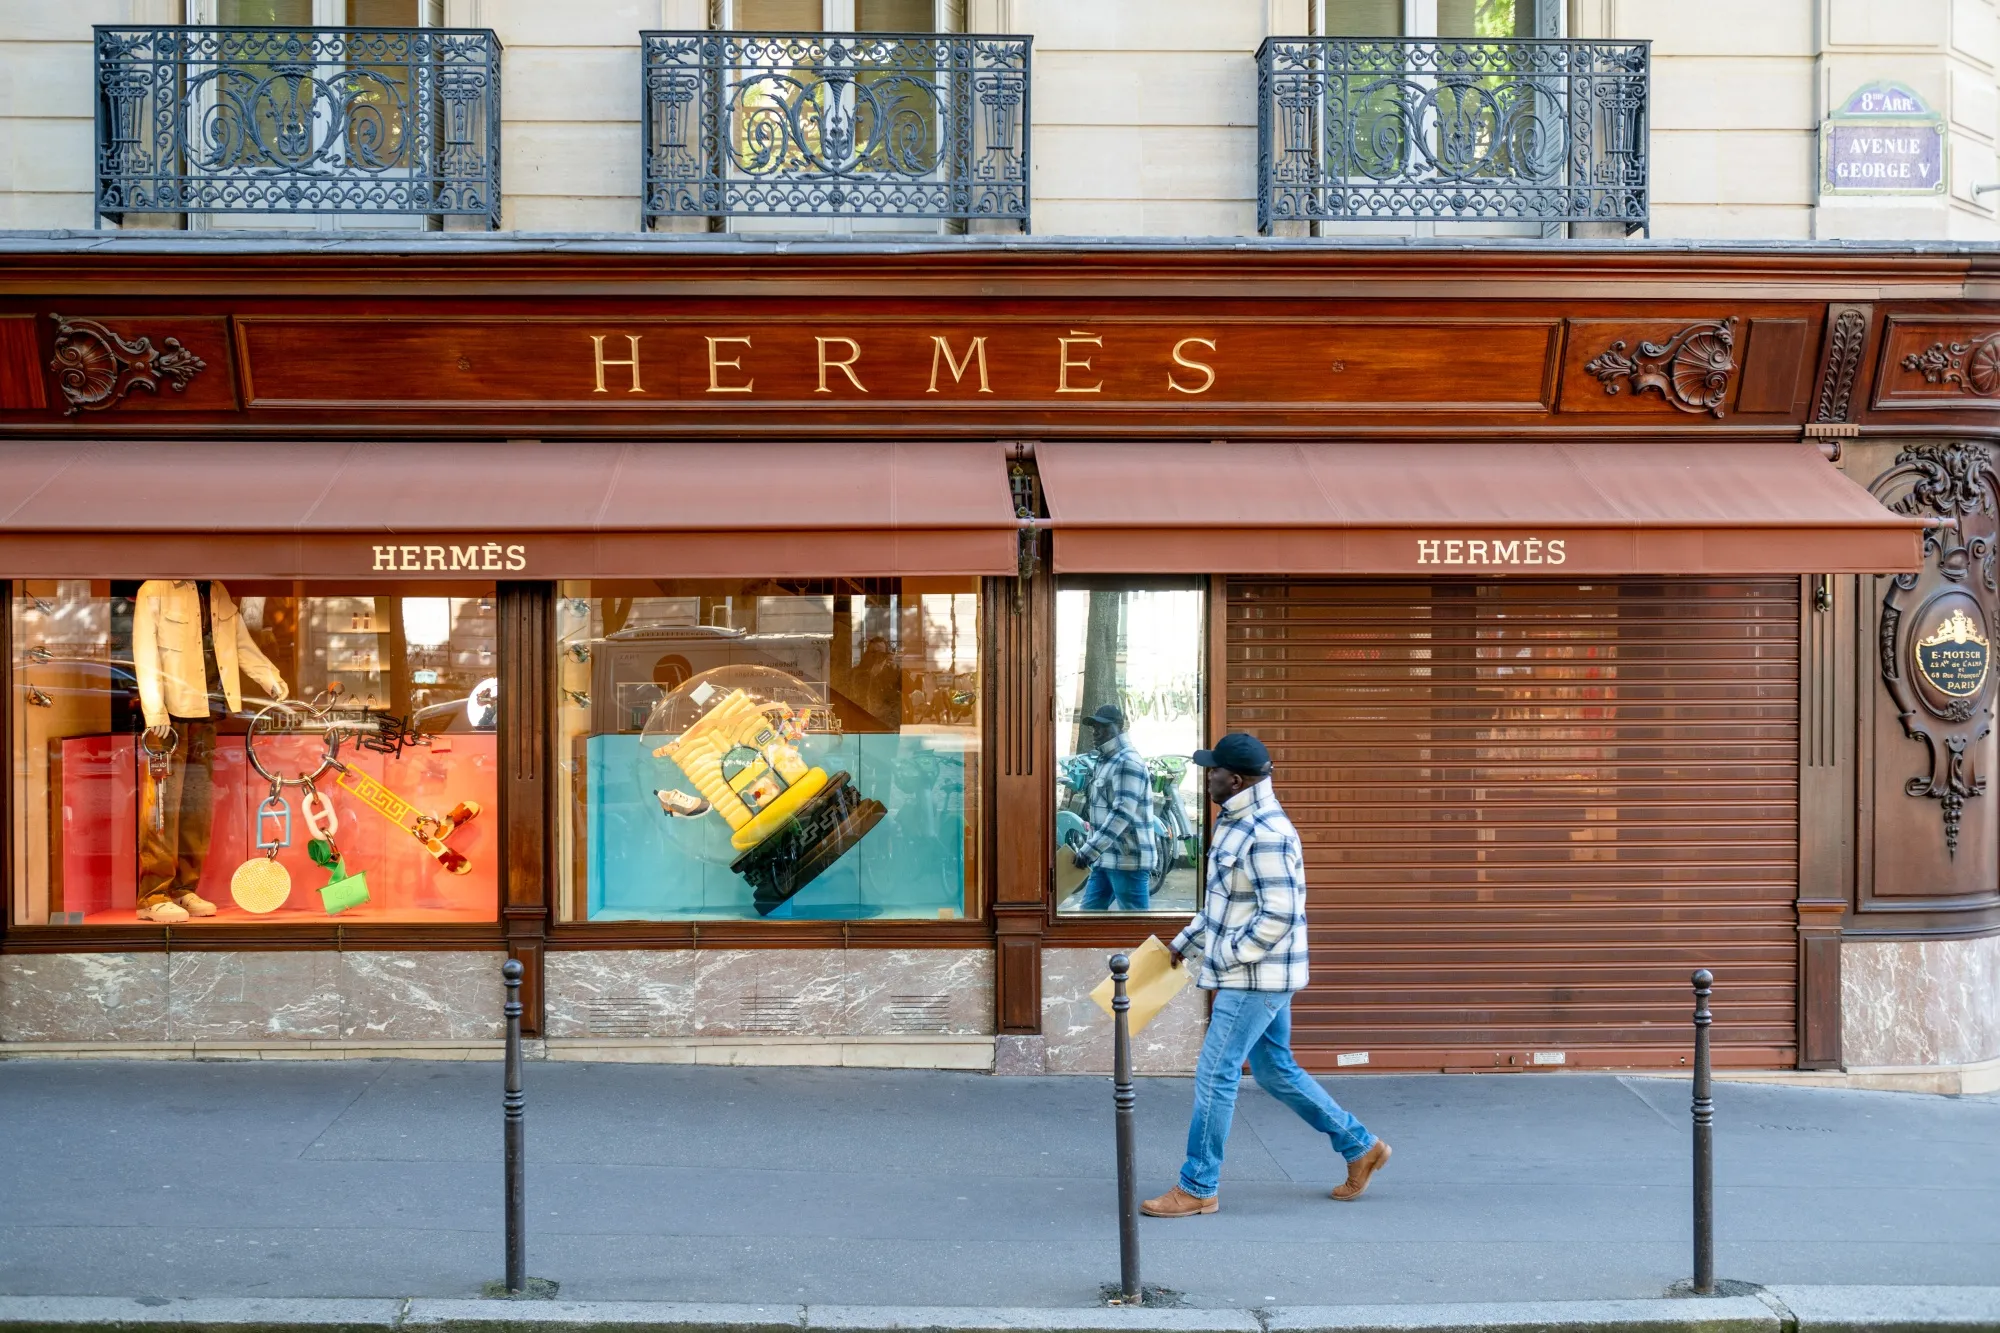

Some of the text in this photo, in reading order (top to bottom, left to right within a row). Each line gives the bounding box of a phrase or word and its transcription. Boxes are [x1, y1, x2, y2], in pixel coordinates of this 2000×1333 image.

[1850, 138, 1921, 154] AVENUE
[1837, 162, 1931, 178] GEORGE V
[372, 542, 526, 571] HERMÈS
[1417, 537, 1566, 565] HERMÈS
[1947, 681, 1975, 689] PARIS
